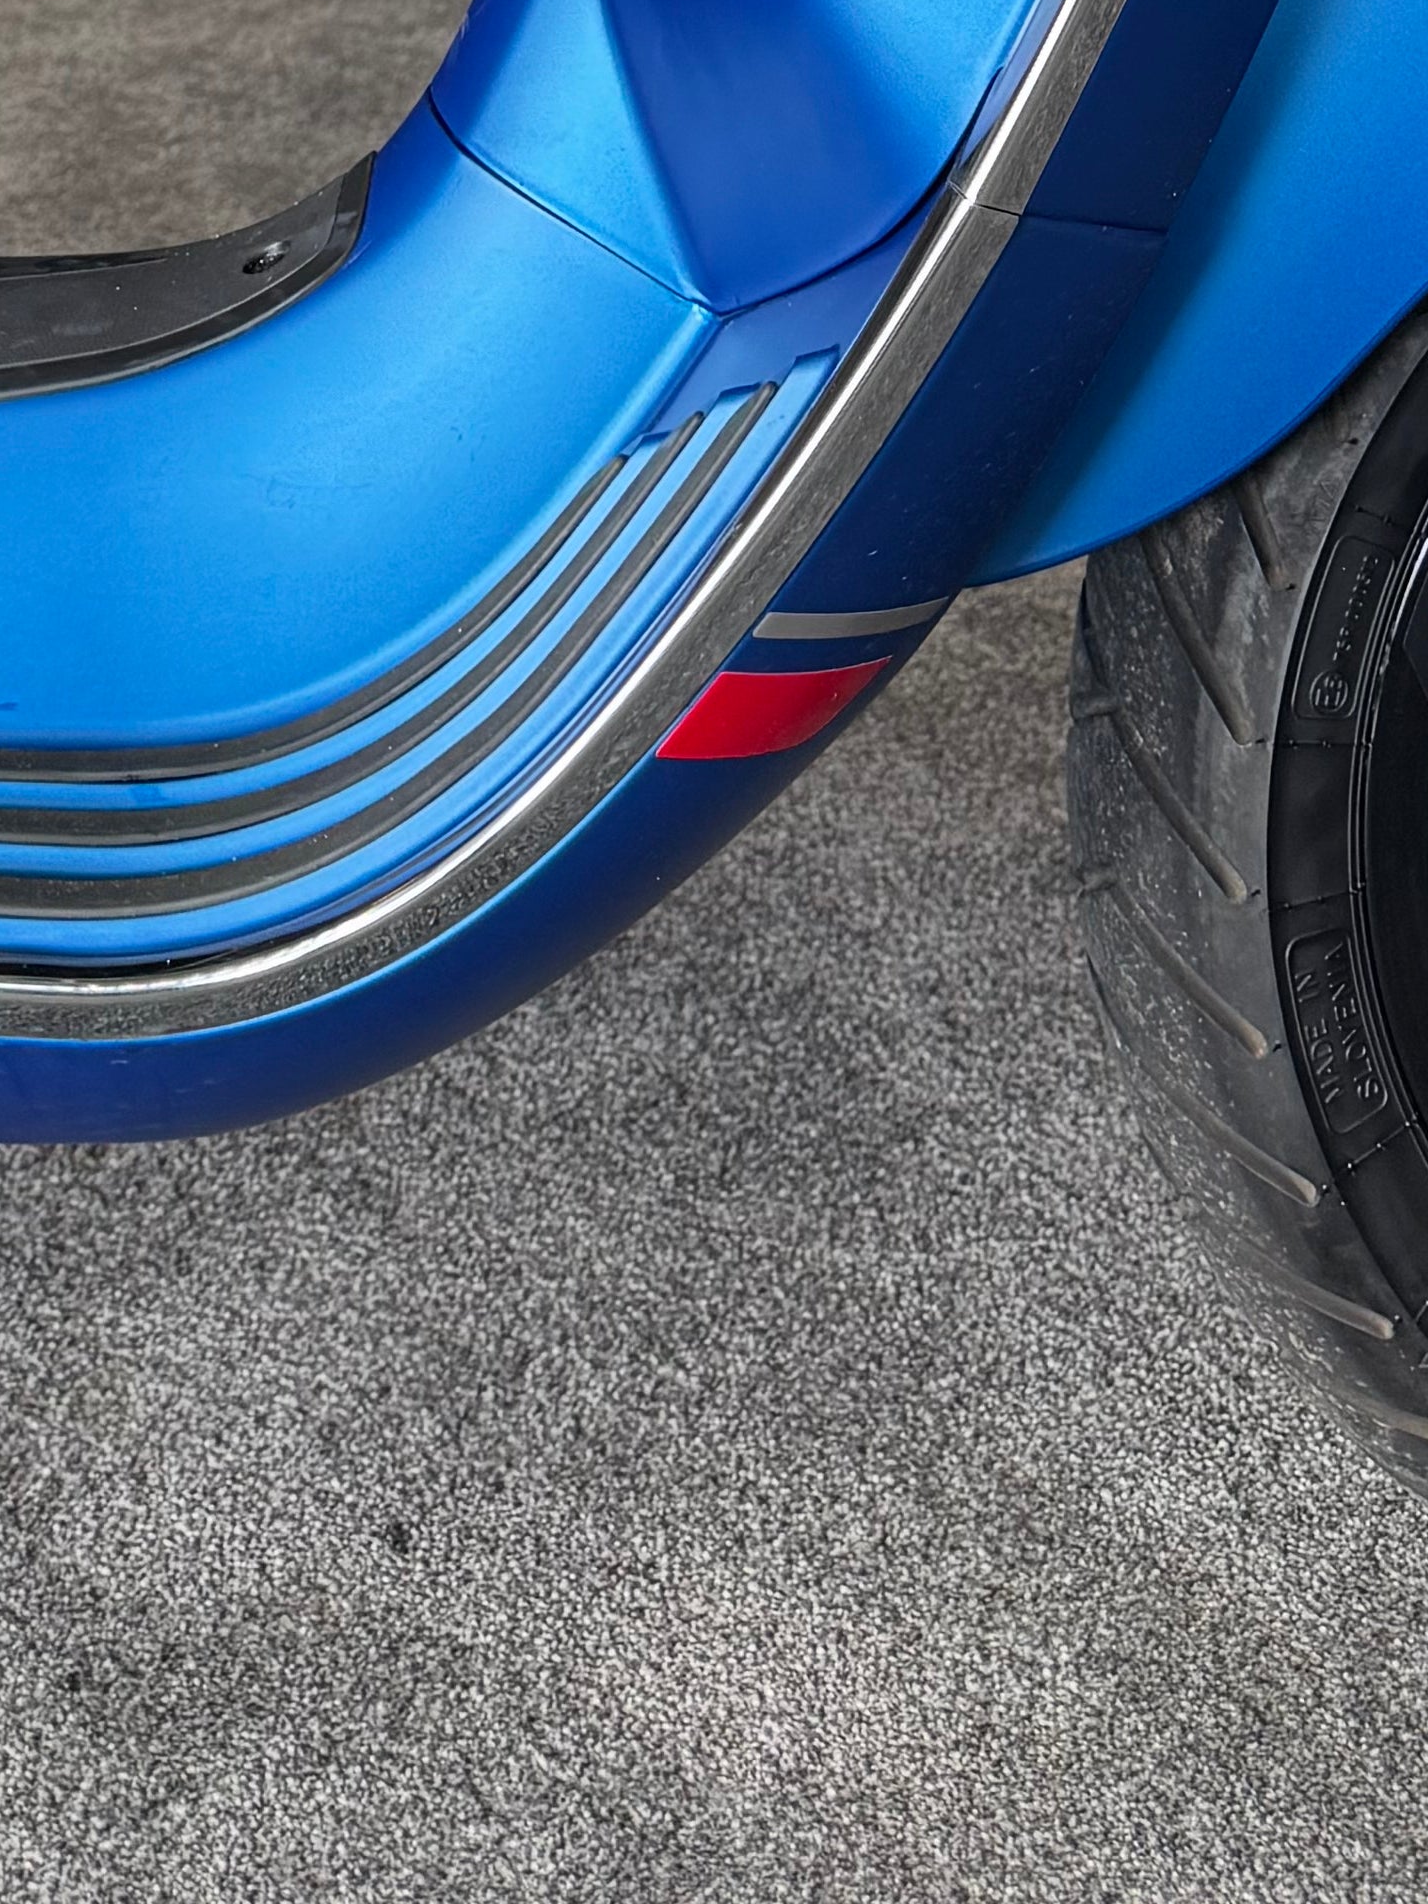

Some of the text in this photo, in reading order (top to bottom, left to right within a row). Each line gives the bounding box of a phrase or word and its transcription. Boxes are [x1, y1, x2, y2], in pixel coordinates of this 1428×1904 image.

[1294, 967, 1341, 1104] MADE IN
[1324, 942, 1380, 1100] SLOVENIA
